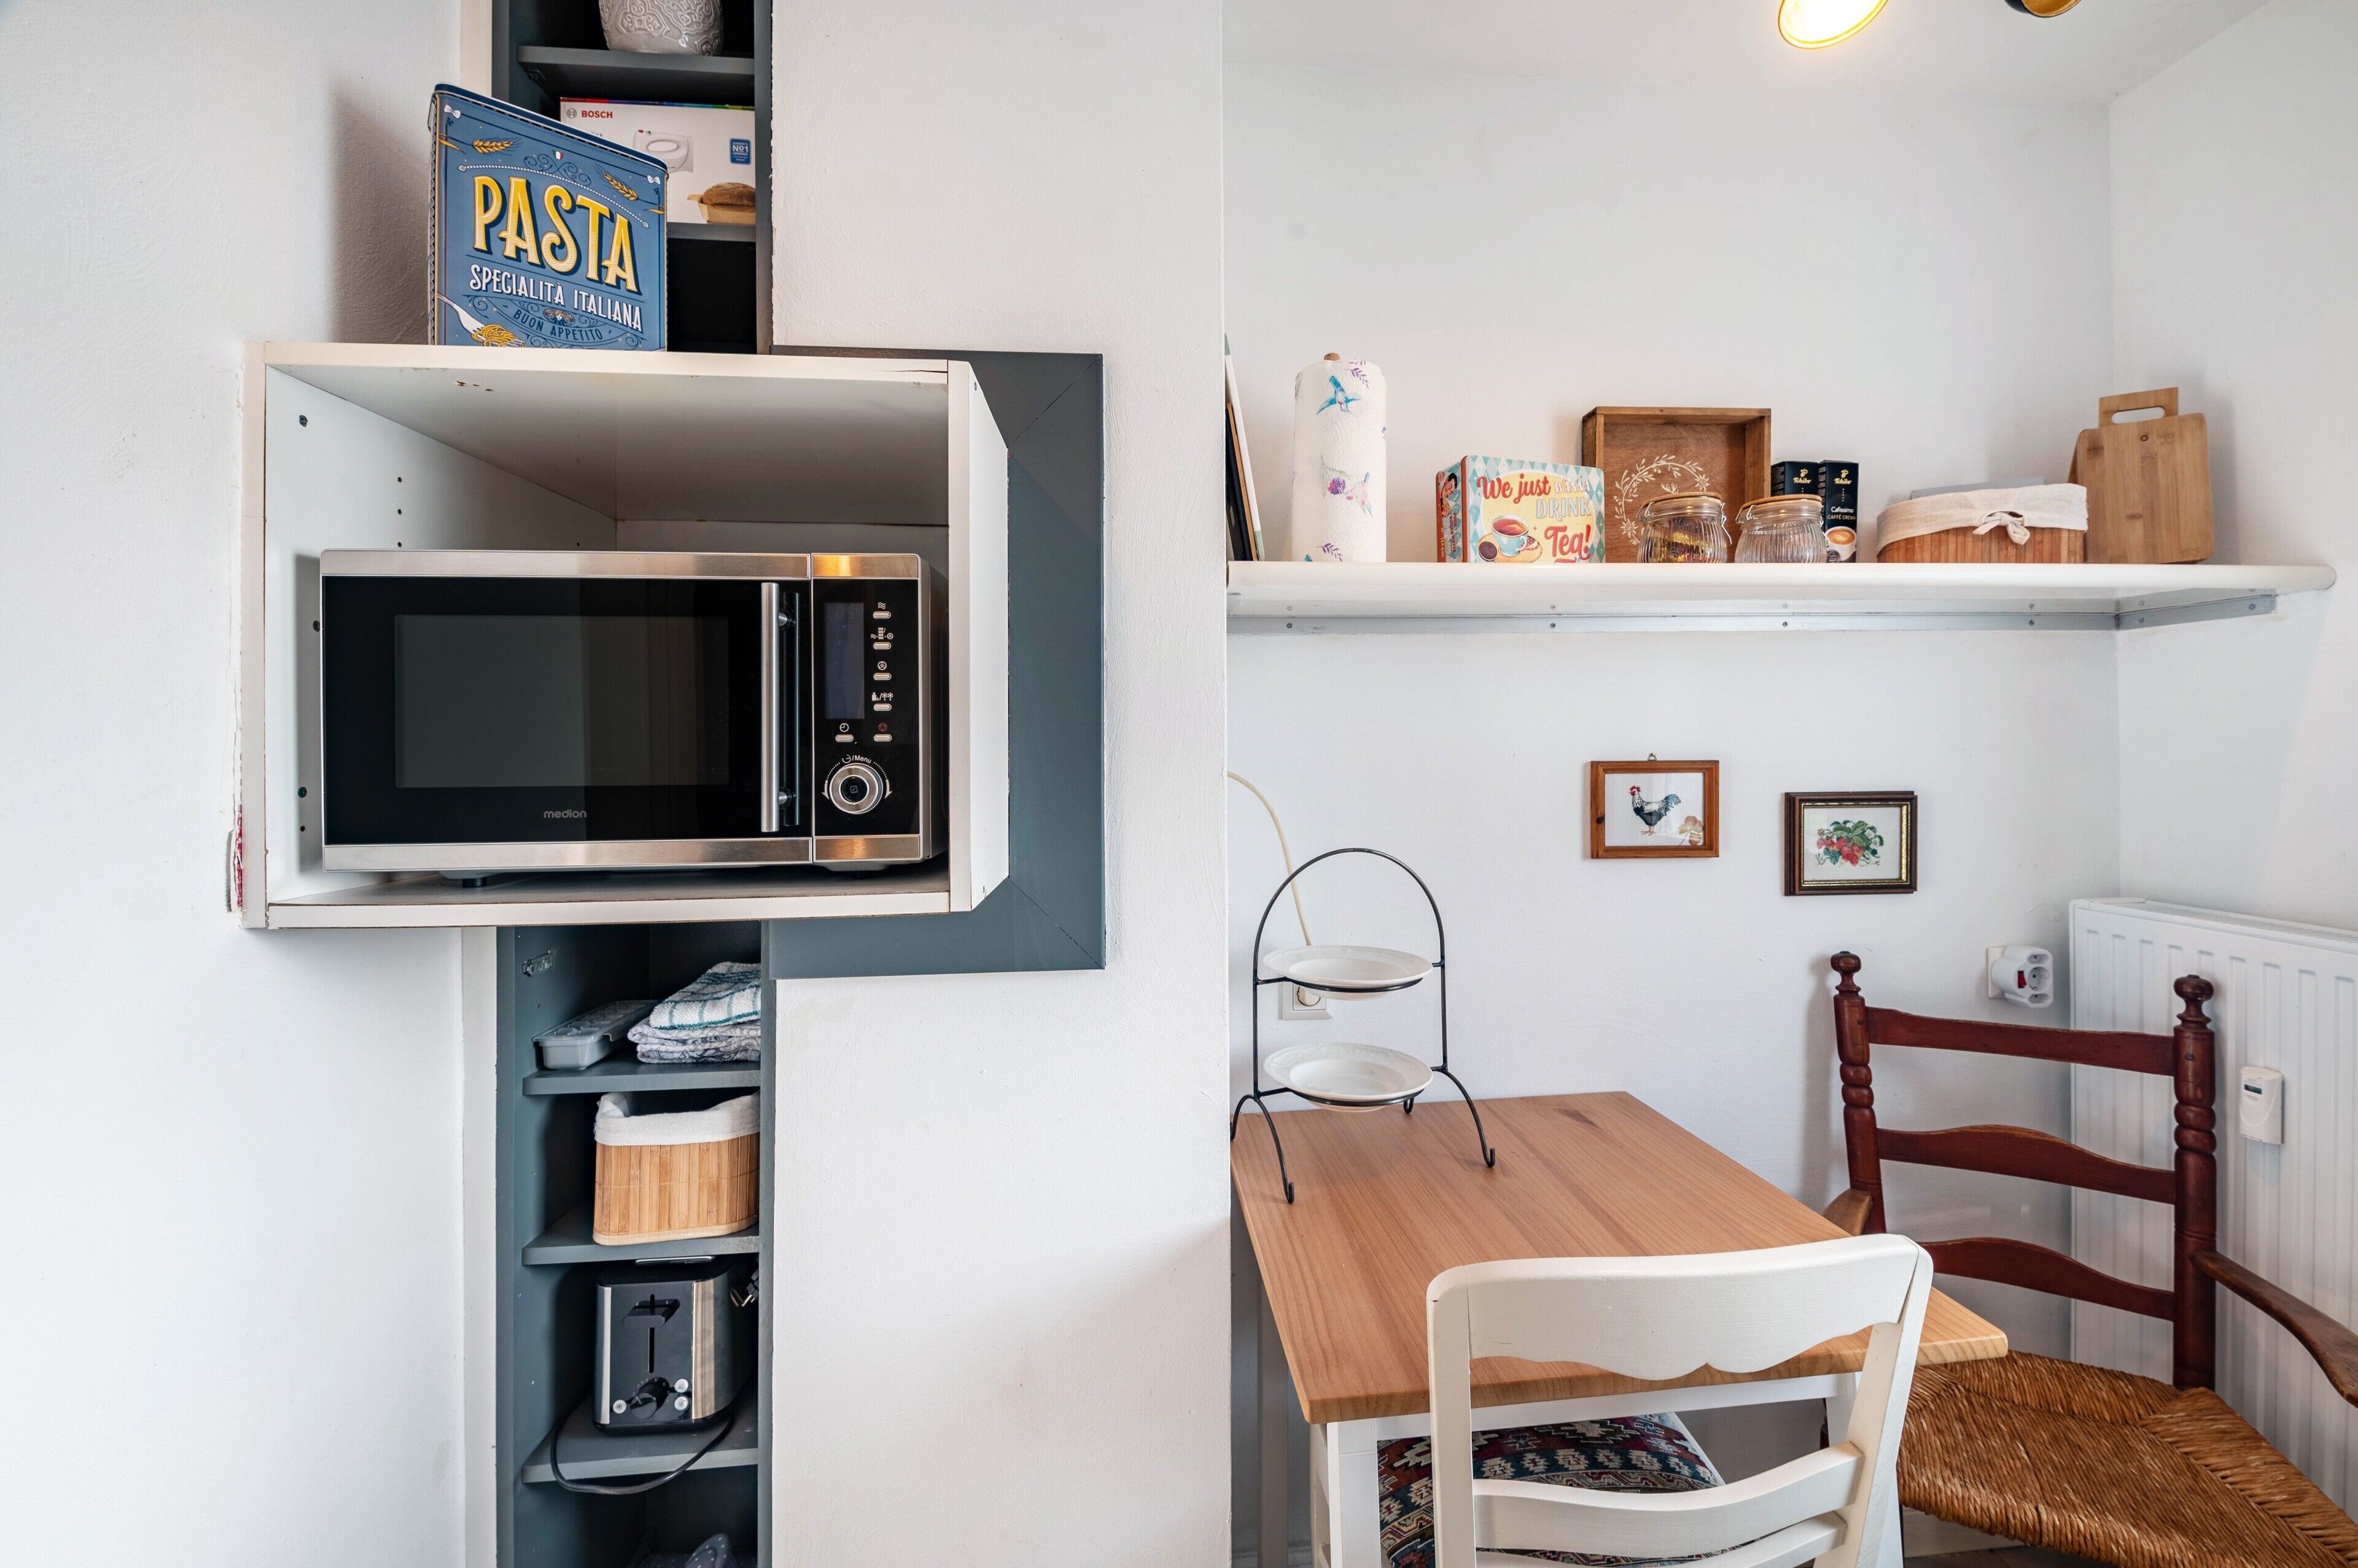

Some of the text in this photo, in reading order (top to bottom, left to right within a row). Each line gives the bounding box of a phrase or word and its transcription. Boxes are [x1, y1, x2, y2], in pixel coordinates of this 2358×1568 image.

[581, 110, 613, 118] BOSCH
[473, 175, 641, 294] PASTA
[469, 264, 644, 334] SPECIALITÀ ITALIANA
[513, 308, 603, 341] BUON APPETITO
[1476, 473, 1590, 504] We just WANNA
[1536, 497, 1592, 522] DRINK
[1544, 524, 1592, 561] Tea!
[543, 809, 587, 818] medion
